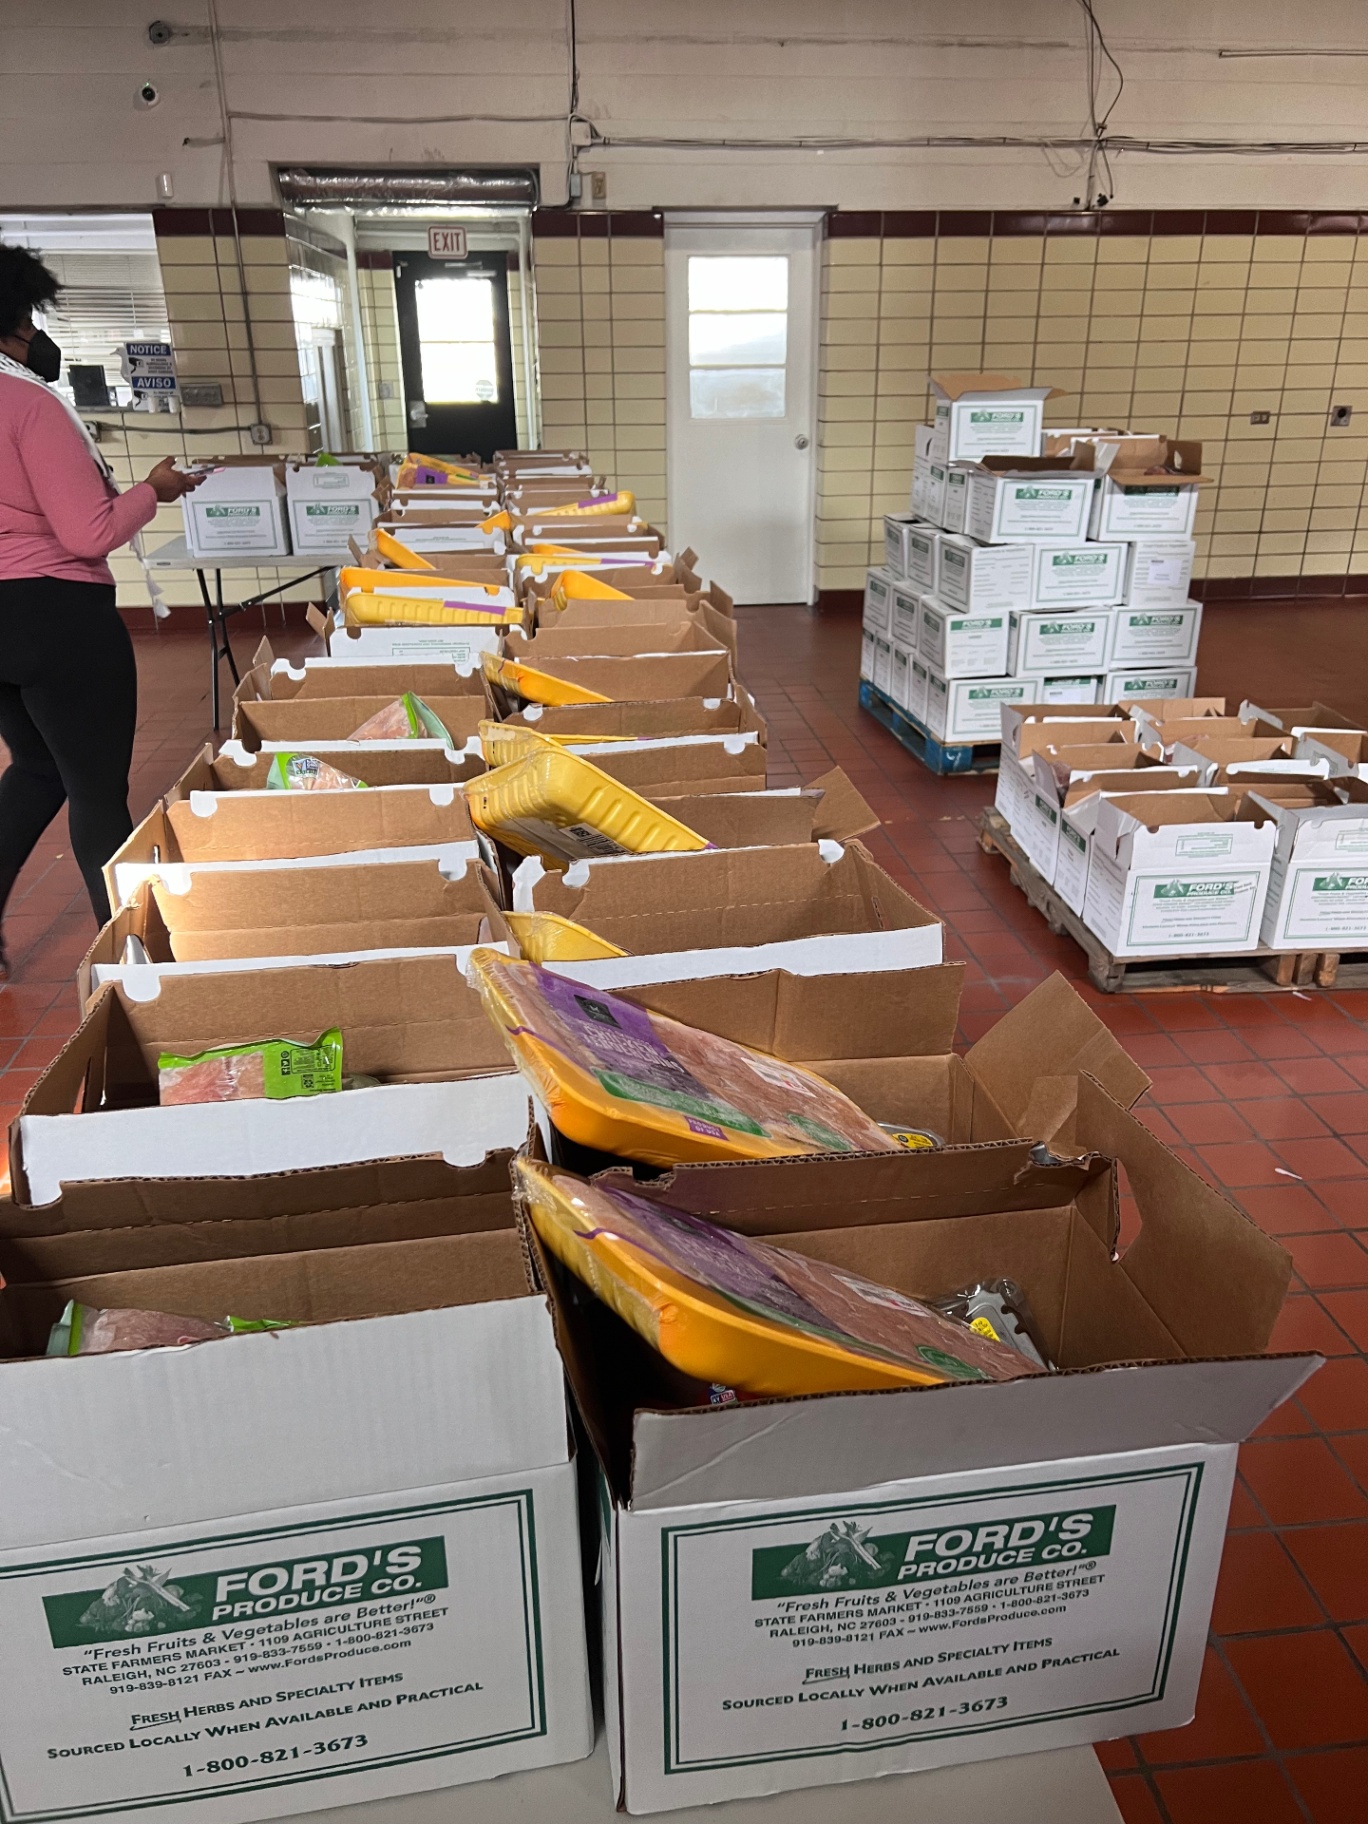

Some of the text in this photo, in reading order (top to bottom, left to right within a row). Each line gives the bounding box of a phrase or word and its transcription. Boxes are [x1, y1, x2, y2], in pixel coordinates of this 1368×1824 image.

[433, 232, 461, 251] EXIT
[130, 345, 167, 354] NOTICE
[137, 378, 171, 387] AVISO
[1189, 882, 1233, 891] FORD'S
[904, 1513, 1094, 1562] FORD'S
[215, 1545, 422, 1603] FORD'S
[897, 1541, 1087, 1580] PRODUCE CO.
[212, 1574, 422, 1621] PRODUCE CO.
[755, 1574, 1105, 1628] STATE FARMERS MARKET 1109 AGRICULTURE STREET
[835, 1595, 880, 1608] Fruits
[885, 1591, 897, 1602] &
[903, 1578, 990, 1601] Vegetables
[994, 1575, 1019, 1587] are
[148, 1637, 197, 1651] Fruits
[203, 1633, 216, 1643] &
[222, 1616, 318, 1640] Vegetables
[324, 1610, 351, 1624] are
[769, 1623, 833, 1638] RALEIGH,
[837, 1620, 856, 1631] NC
[859, 1614, 896, 1630] 27603
[908, 1605, 988, 1622] 919-833-7559
[1000, 1589, 1090, 1609] 1-800-821-3673
[792, 1633, 874, 1648] 919-839-8121
[878, 1627, 904, 1640] FAX
[918, 1605, 1067, 1633] www.FordsProduce.com
[62, 1607, 449, 1676] STATE FARMERS MARKET 1109 AGRICULTURE STREET
[82, 1670, 151, 1686] RALEIGH,
[156, 1666, 177, 1676] NC
[181, 1658, 221, 1672] 27603
[234, 1641, 322, 1664] 919-833-7559
[335, 1622, 434, 1646] 1-800-821-3673
[110, 1674, 199, 1694] 919-839-8121
[204, 1668, 232, 1681] FAX
[248, 1639, 412, 1674] www.FordsProduce.com
[903, 1656, 934, 1668] AND
[1005, 1662, 1038, 1675] AND
[238, 1695, 272, 1709] AND
[356, 1698, 392, 1712] AND
[841, 1696, 1008, 1731] 1-800-821-3673
[183, 1734, 368, 1777] 1-800-821-3673
